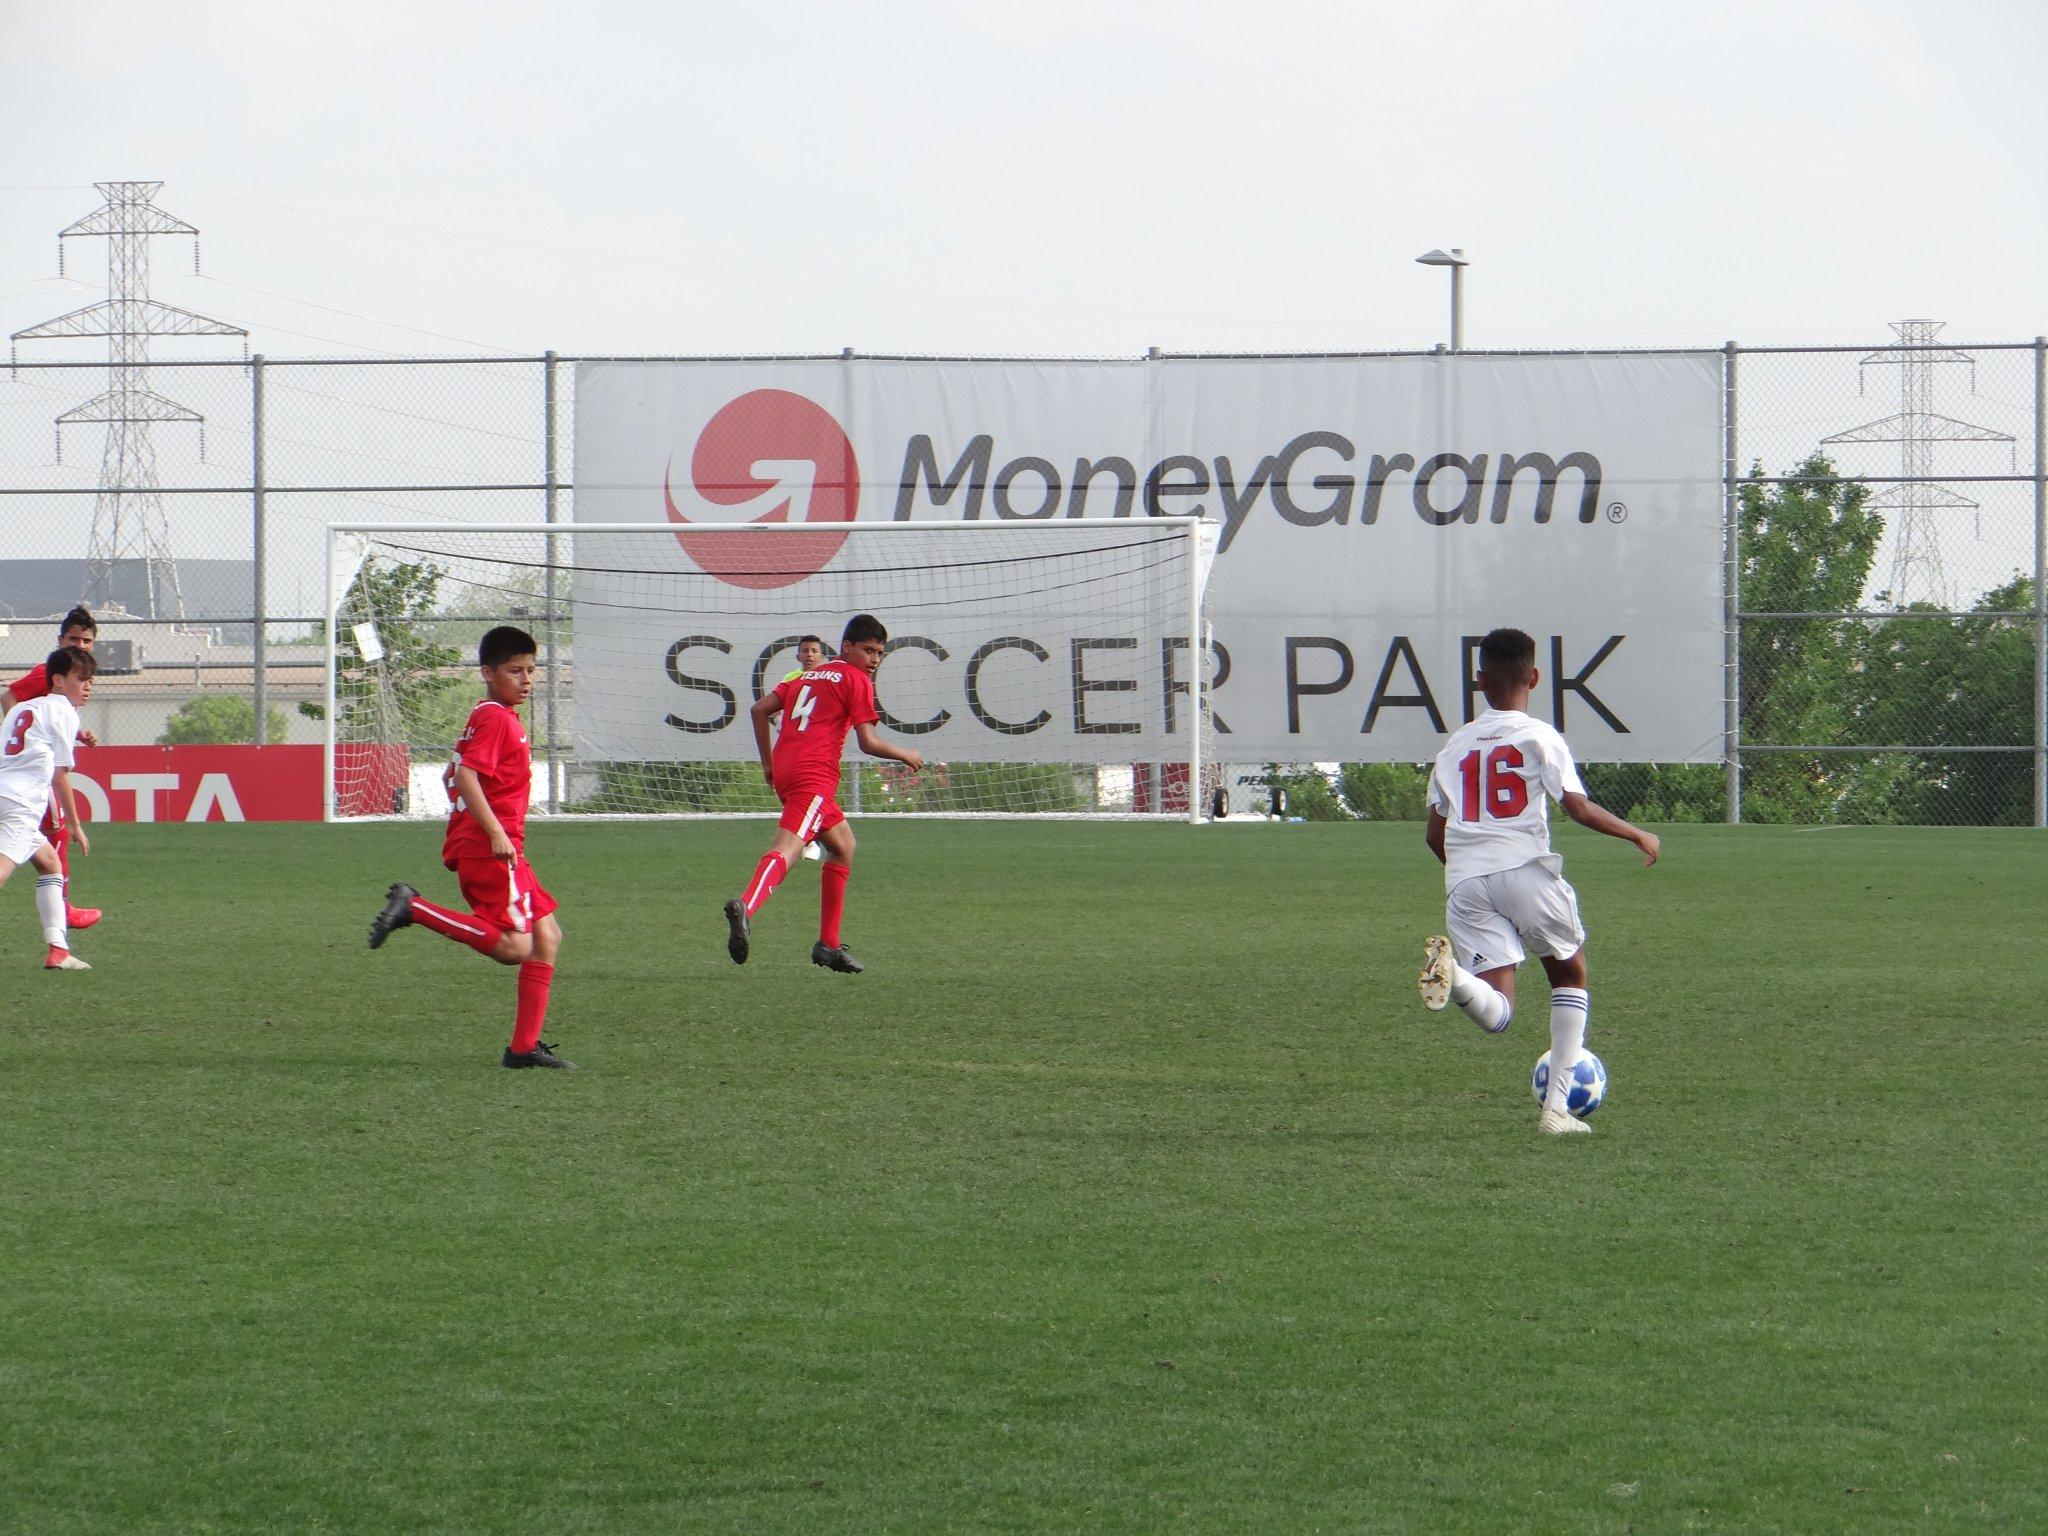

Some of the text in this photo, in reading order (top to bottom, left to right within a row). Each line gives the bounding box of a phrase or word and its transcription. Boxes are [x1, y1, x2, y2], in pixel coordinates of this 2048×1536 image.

[801, 670, 842, 682] TEXANS
[791, 685, 816, 732] 4
[1459, 744, 1528, 822] 16
